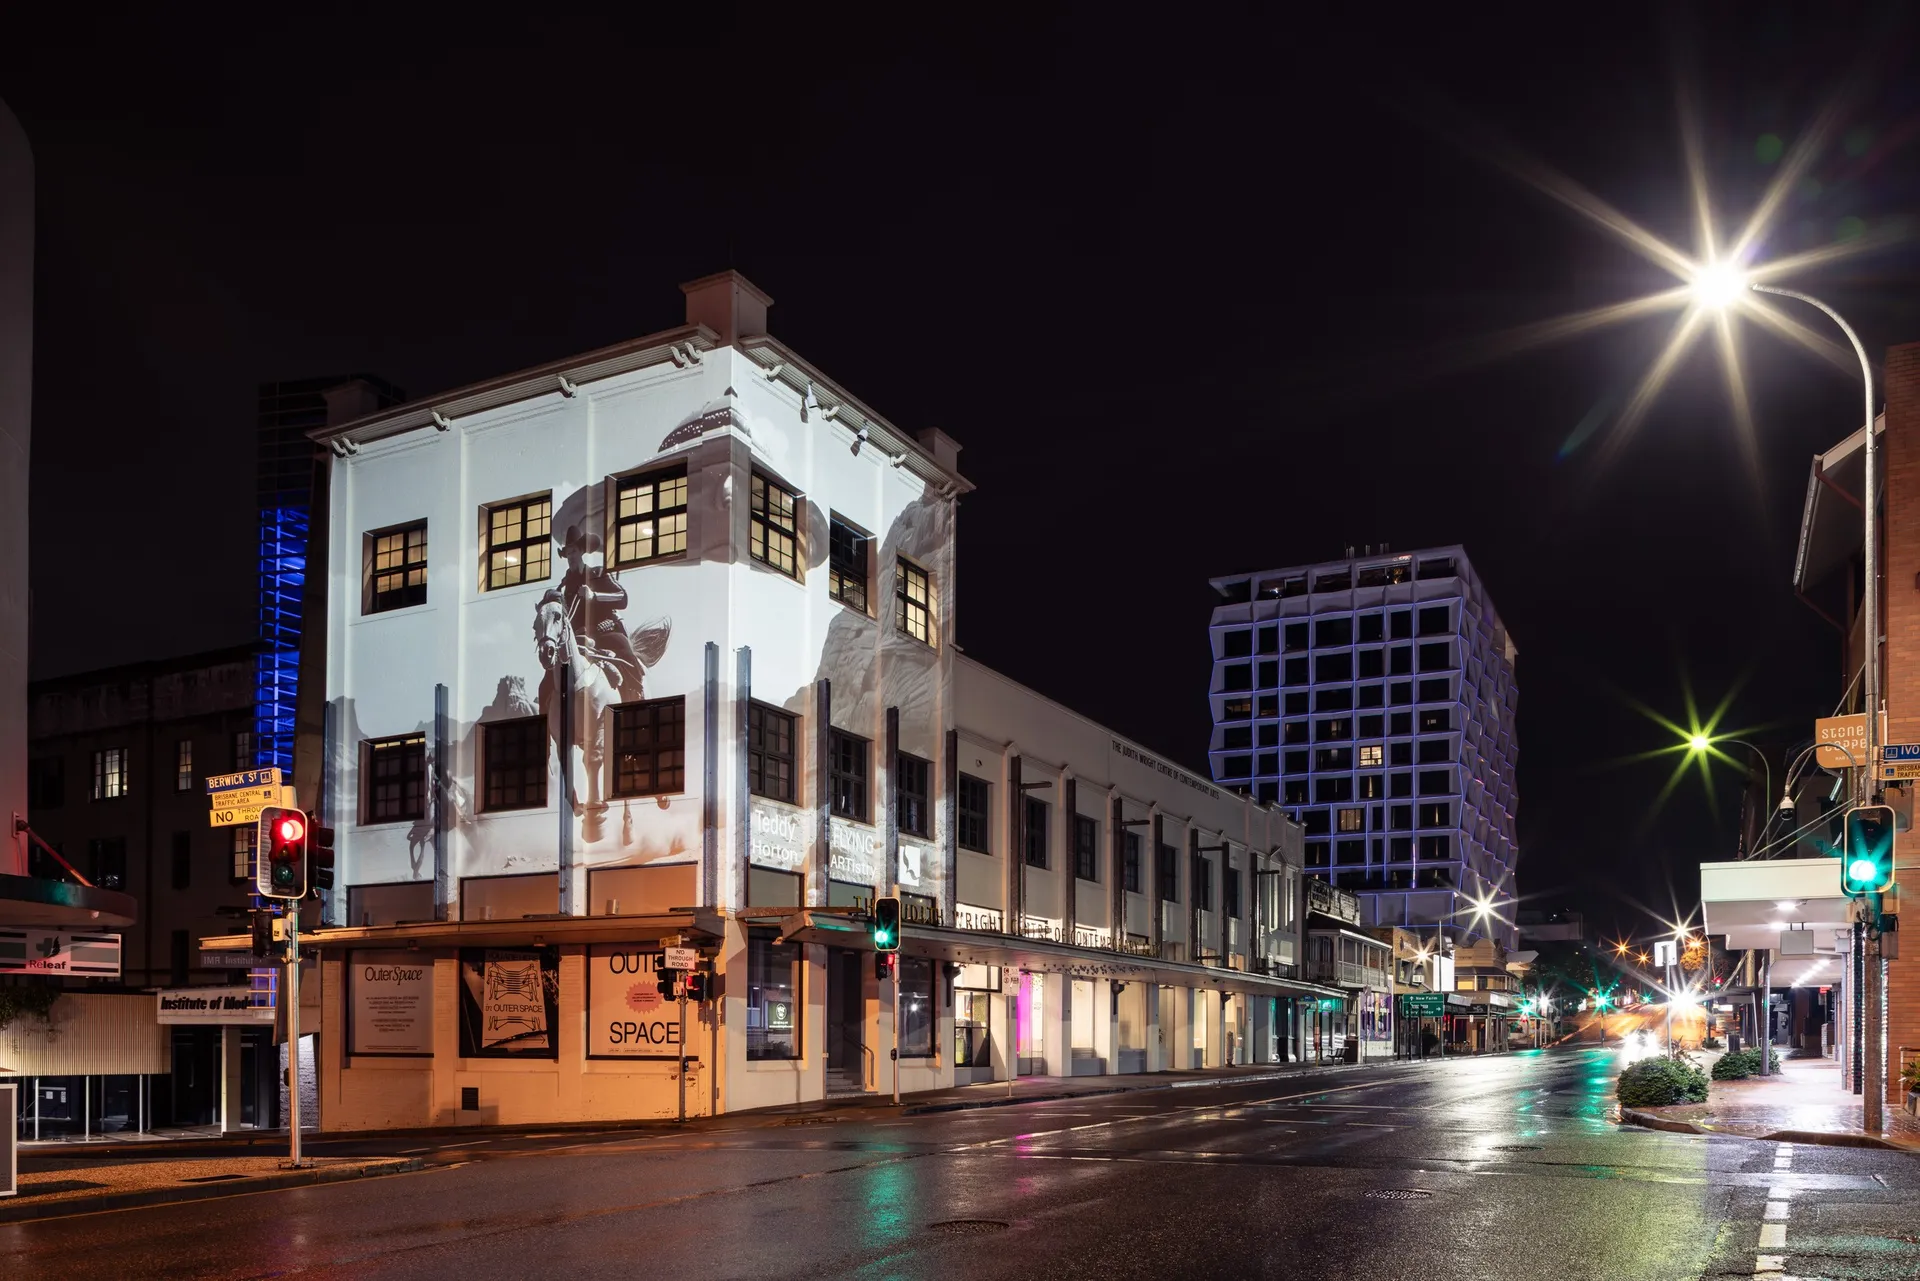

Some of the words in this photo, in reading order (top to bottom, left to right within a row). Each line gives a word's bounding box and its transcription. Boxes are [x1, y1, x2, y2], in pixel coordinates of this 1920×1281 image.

[1112, 740, 1122, 754] THE
[1122, 745, 1138, 762] JUDITH
[1139, 753, 1156, 771] WRIGHT
[1157, 762, 1173, 778] CENTRE
[1173, 770, 1180, 780] OF
[209, 774, 245, 788] BERWICK
[214, 793, 238, 801] BRISBANE
[240, 790, 261, 798] CENTRAL
[216, 811, 234, 824] NO
[754, 809, 796, 842] Teddy
[833, 826, 874, 854] FLYING
[752, 838, 798, 862] Horton
[853, 896, 875, 917] TH
[900, 903, 944, 927] UDITH
[29, 959, 67, 970] Releaf
[225, 956, 256, 965] Institut
[160, 996, 208, 1010] Institute
[209, 996, 222, 1010] of
[494, 1004, 519, 1012] OUTER
[520, 1004, 543, 1013] SPACE
[610, 1022, 680, 1044] SPACE
